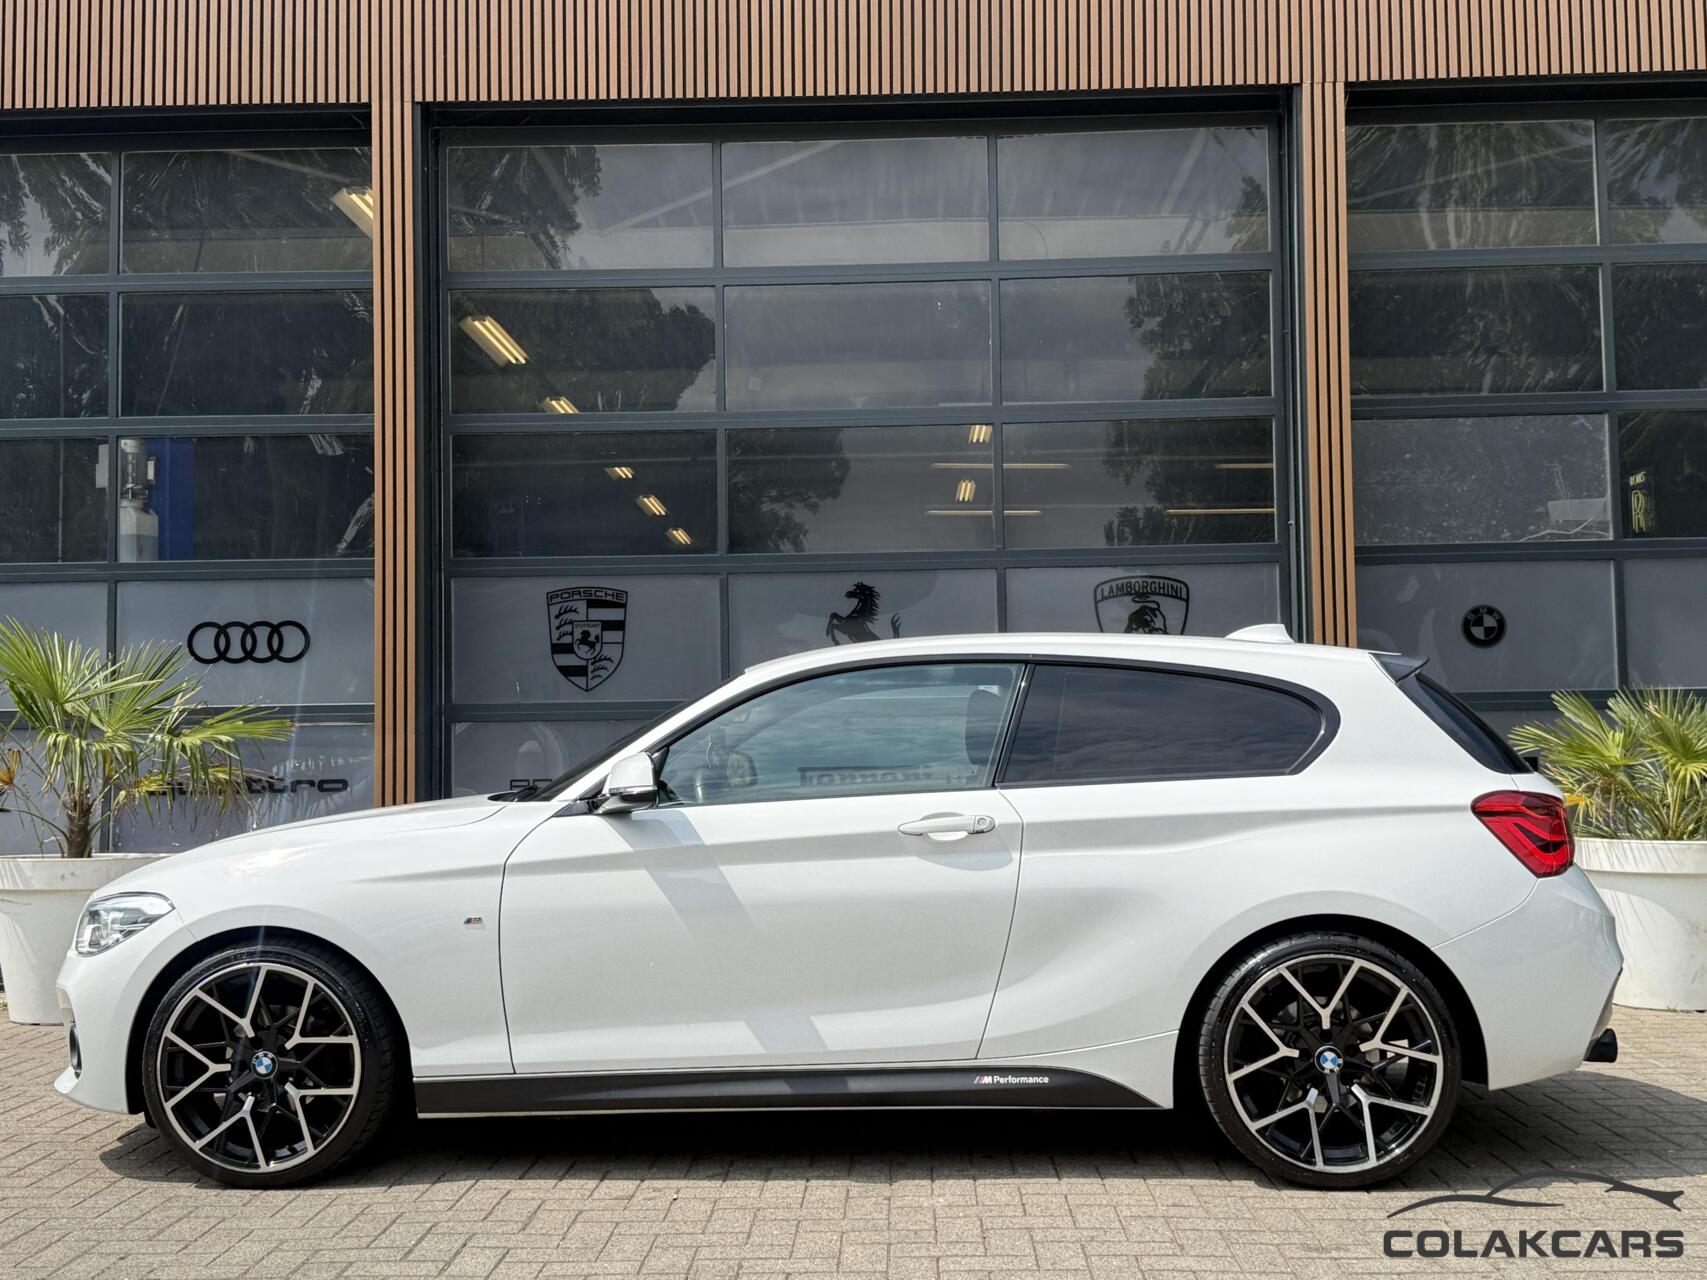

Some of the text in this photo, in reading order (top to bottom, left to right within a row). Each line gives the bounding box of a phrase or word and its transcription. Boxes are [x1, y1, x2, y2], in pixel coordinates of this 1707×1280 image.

[549, 590, 625, 602] PORSCHE
[1101, 581, 1183, 600] LAMBORGHINI
[993, 1075, 1049, 1084] Performance
